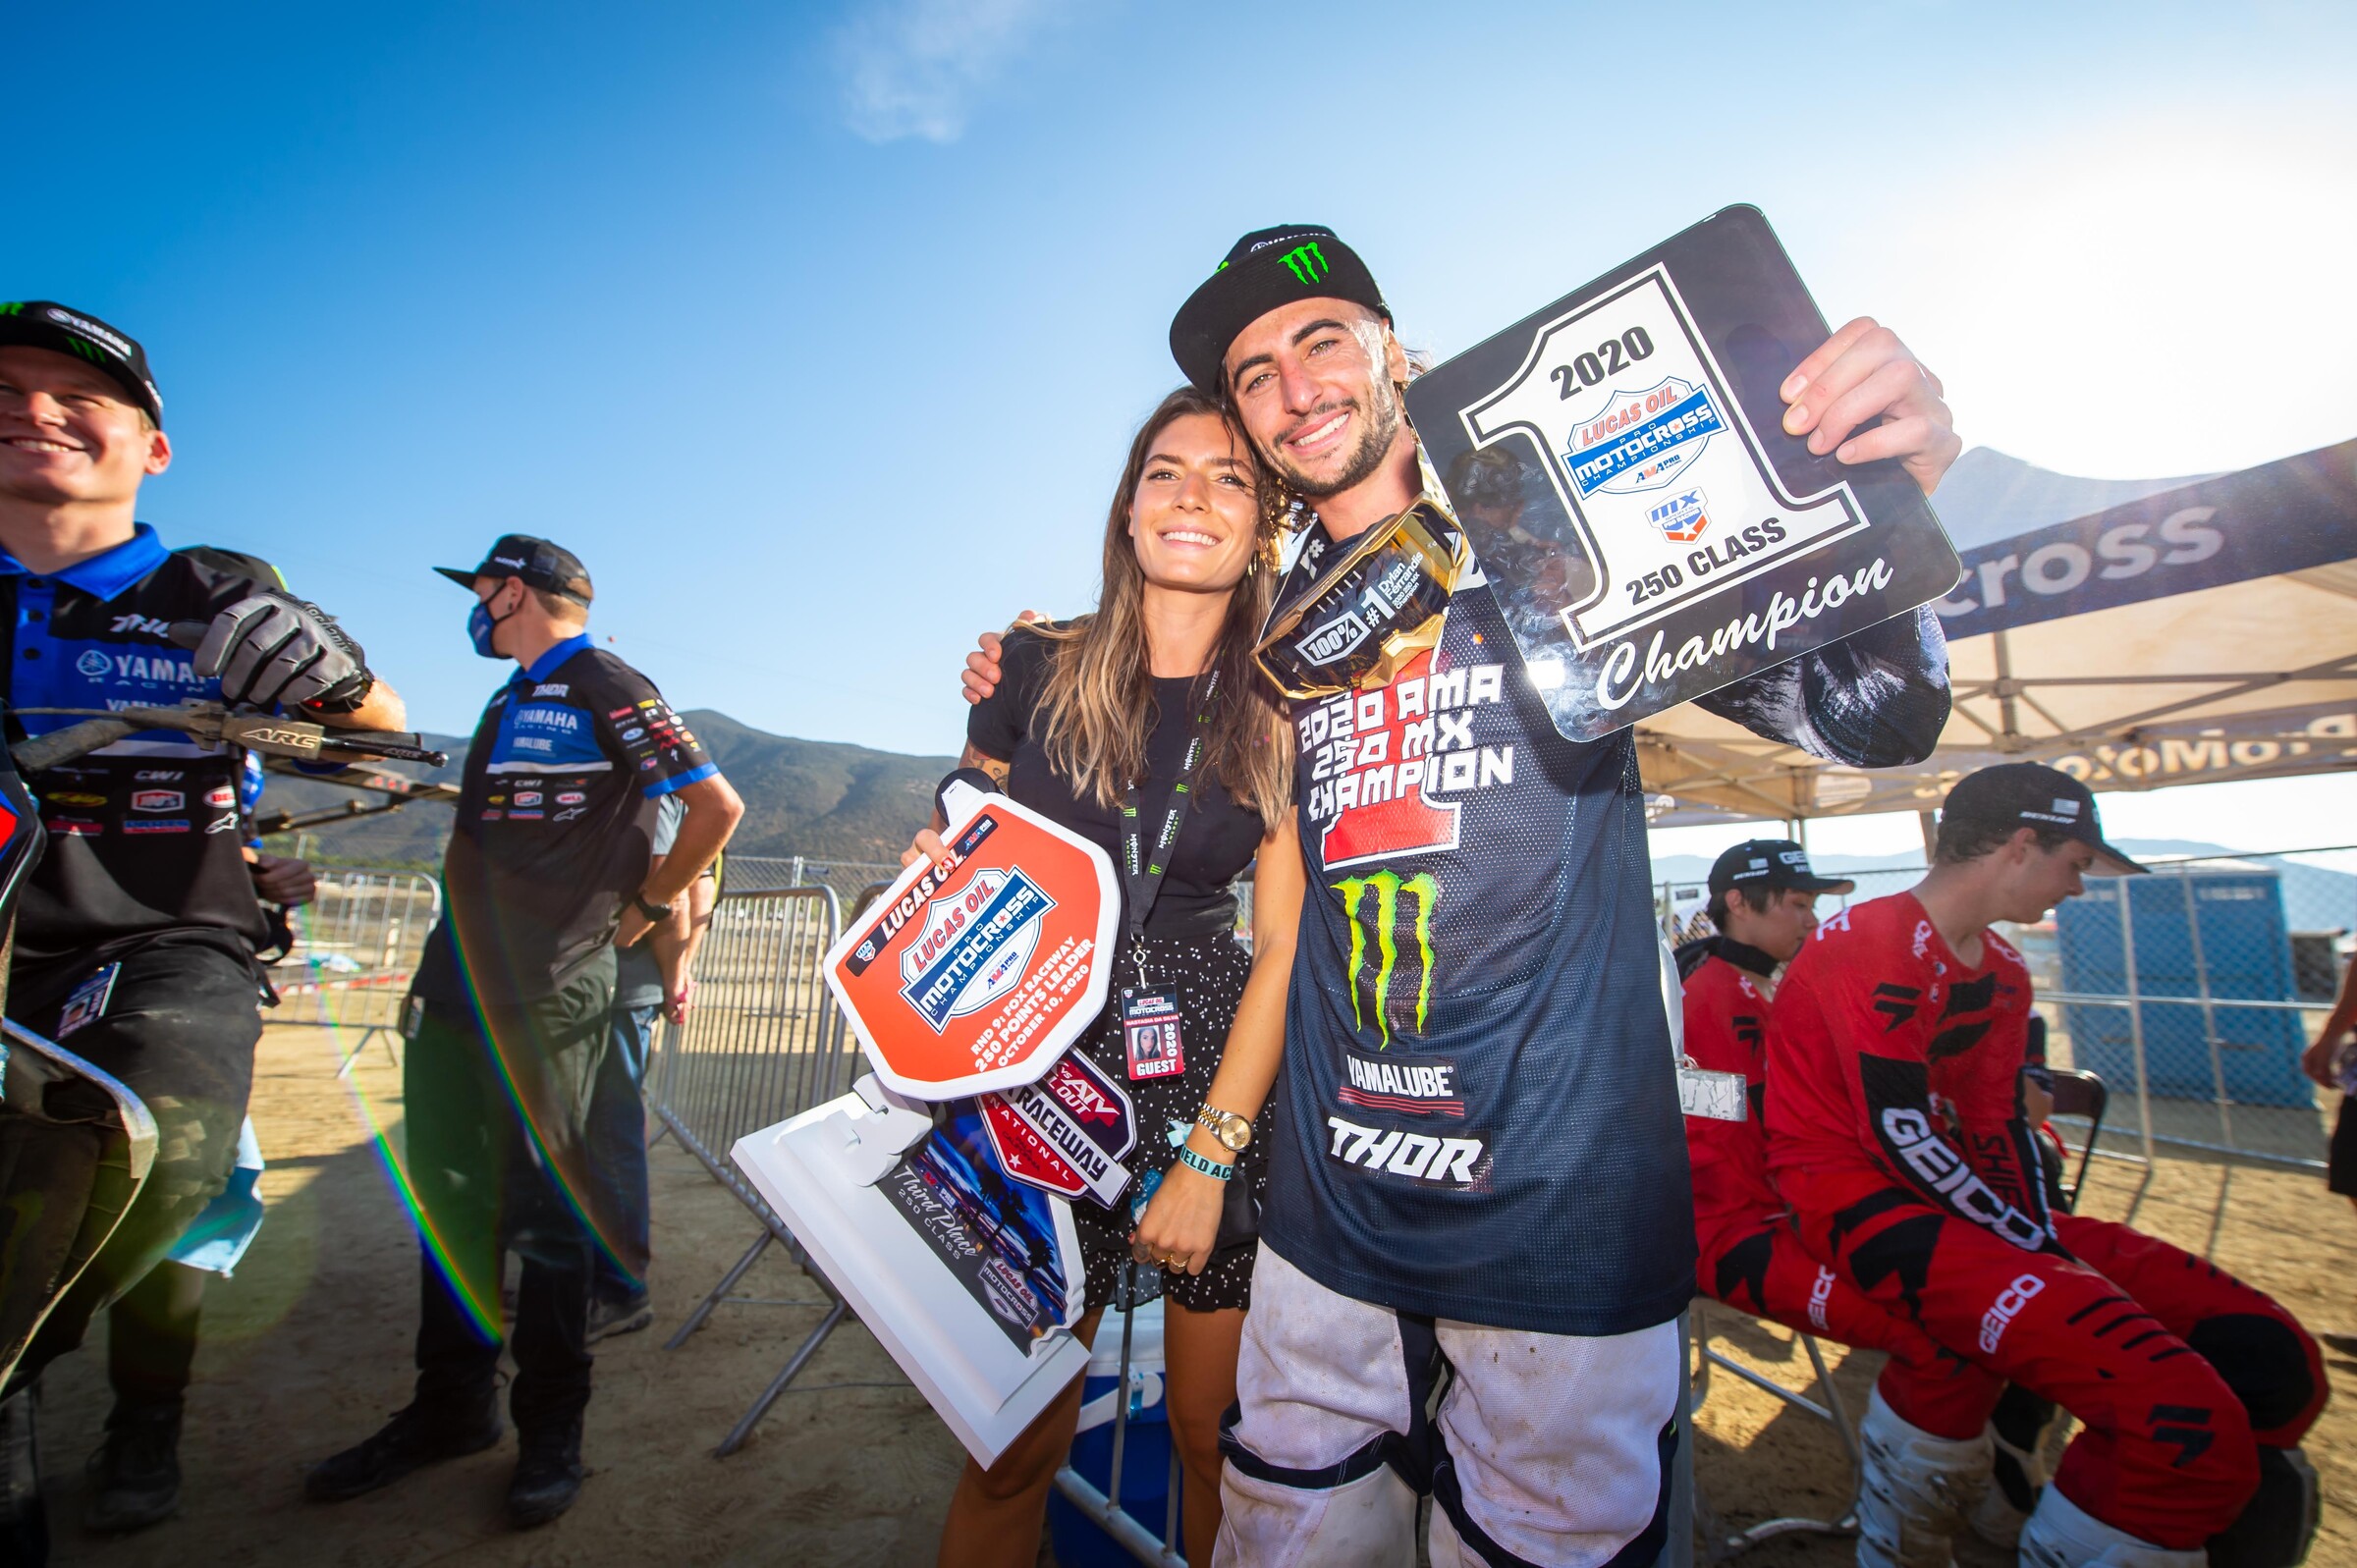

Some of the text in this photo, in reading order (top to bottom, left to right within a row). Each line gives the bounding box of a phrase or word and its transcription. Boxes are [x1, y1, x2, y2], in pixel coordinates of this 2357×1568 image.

[1549, 325, 1656, 402] 2020
[1575, 404, 1713, 481] MOTOCROSS
[1582, 386, 1678, 447] LUCAS OIL
[1619, 422, 1657, 445] PRO
[1581, 416, 1716, 487] CHAMPIONSHIP
[1635, 455, 1680, 484] AMA PRO
[1651, 490, 1700, 522] MX
[1378, 562, 1405, 593] Dylan
[1384, 551, 1424, 601] Ferrandis
[1626, 517, 1786, 607] 250 CLASS
[1307, 619, 1358, 660] 100%
[1596, 557, 1893, 711] Champion
[115, 655, 220, 683] YAMA
[522, 709, 578, 730] YAMAHA
[1299, 664, 1505, 754] 2020 AMA
[1311, 710, 1474, 782] 250 MX
[1308, 746, 1515, 821] CHAMPION
[1129, 834, 1139, 876] MONSTER
[1158, 809, 1177, 849] MONSTER
[881, 848, 964, 941] LUCAS OL
[912, 880, 995, 973] LUCAS OIL
[919, 886, 1035, 1012] MOTOCROSS
[930, 895, 1039, 1016] CHAMPIONSHIP
[954, 923, 984, 956] PRO
[1004, 951, 1017, 965] PRO
[970, 936, 1075, 1055] RND 9: FOX RACEWAY
[975, 939, 1095, 1073] 250 POINTS LEADER
[997, 964, 1089, 1066] OCTOBER 10, 2020
[1129, 1003, 1174, 1015] MOTOCROSS
[1136, 1059, 1177, 1076] GUEST
[1164, 1023, 1178, 1057] 2020
[1057, 1085, 1091, 1115] OUT
[1060, 1067, 1072, 1079] VS
[1061, 1079, 1121, 1115] ATV
[1346, 1054, 1454, 1098] YAMALUBE
[989, 1097, 1069, 1181] NATIONAL
[1015, 1085, 1109, 1182] RACEWAY
[1180, 1147, 1233, 1179] IELD AC
[1328, 1116, 1484, 1182] THOR
[1882, 1108, 2046, 1251] GEICO
[894, 1164, 978, 1257] Third Place
[898, 1189, 961, 1260] 250 CLASS
[984, 1267, 1033, 1322] MOTOCROSS
[996, 1263, 1022, 1290] LUCAS
[1978, 1273, 2046, 1354] GEICO
